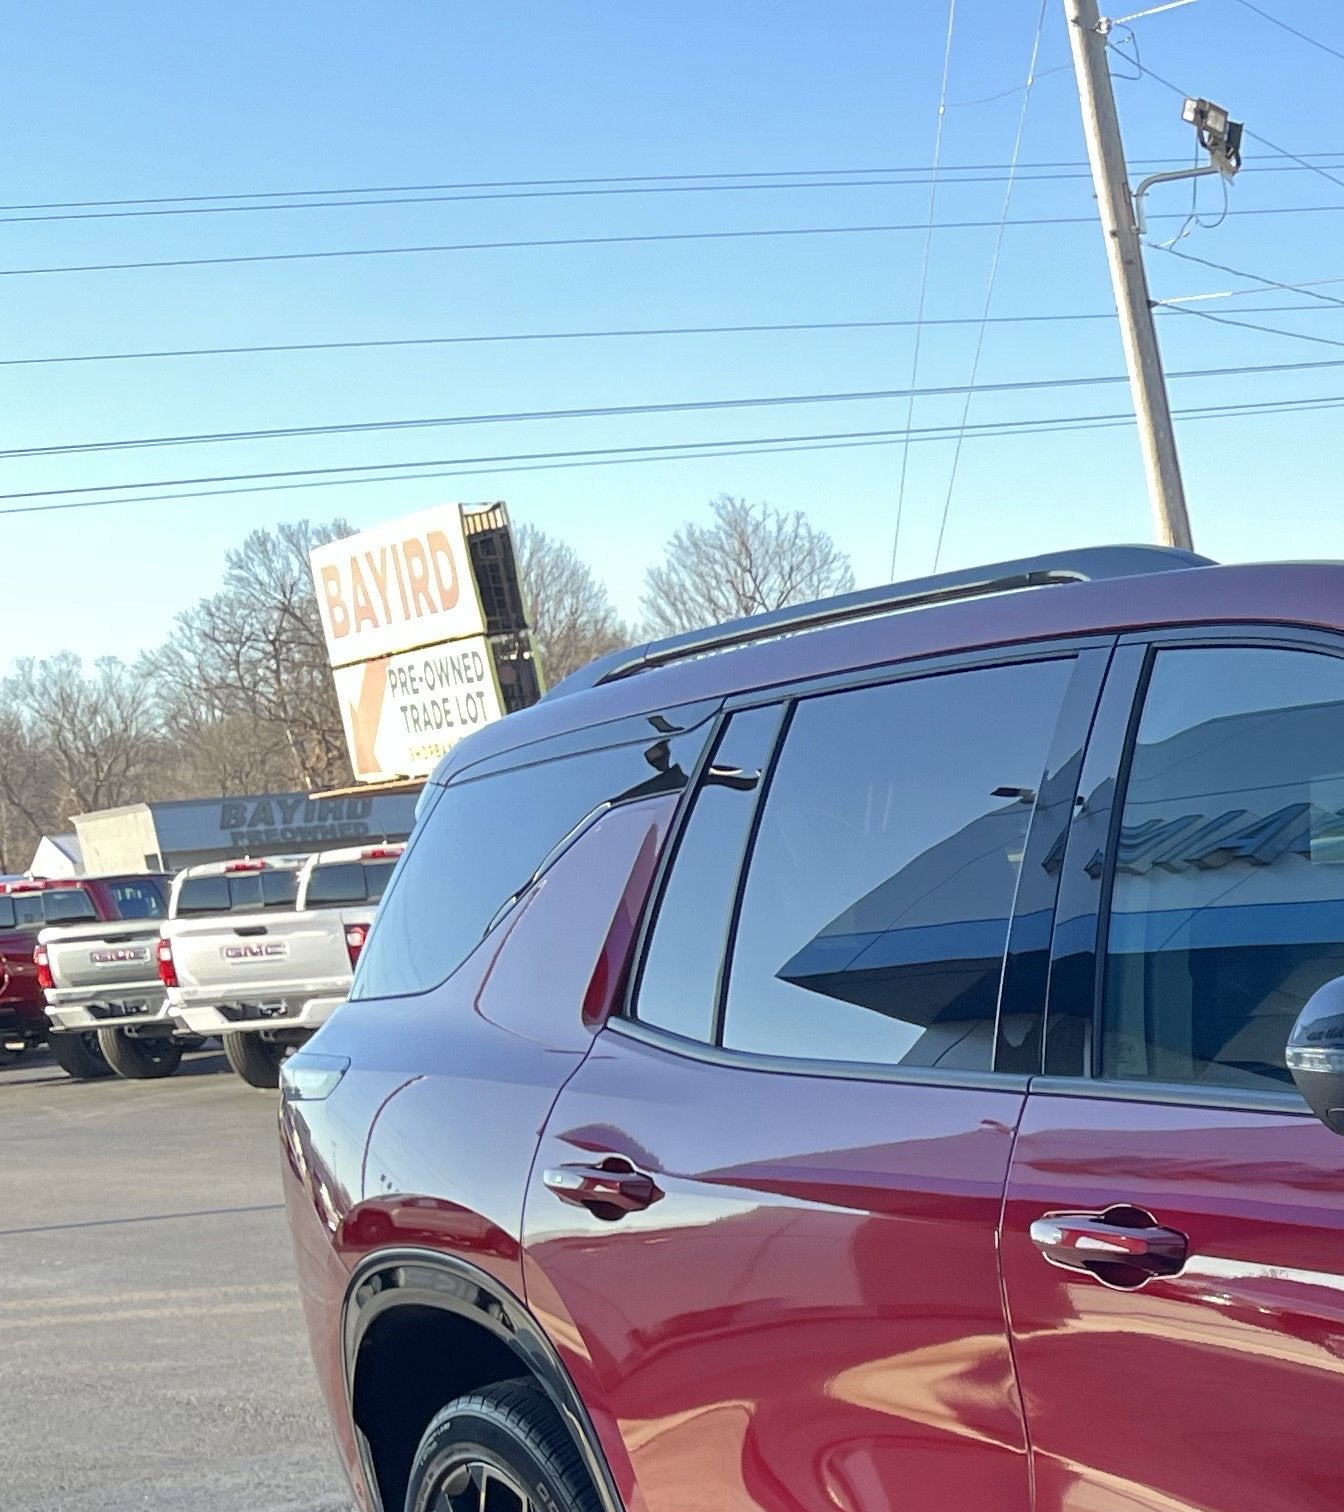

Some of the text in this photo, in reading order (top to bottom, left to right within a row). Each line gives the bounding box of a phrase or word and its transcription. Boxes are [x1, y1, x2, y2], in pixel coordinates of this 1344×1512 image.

[321, 530, 460, 639] BAYIRD
[388, 651, 485, 698] PRE-OWNED
[400, 691, 488, 734] TRADE LOT
